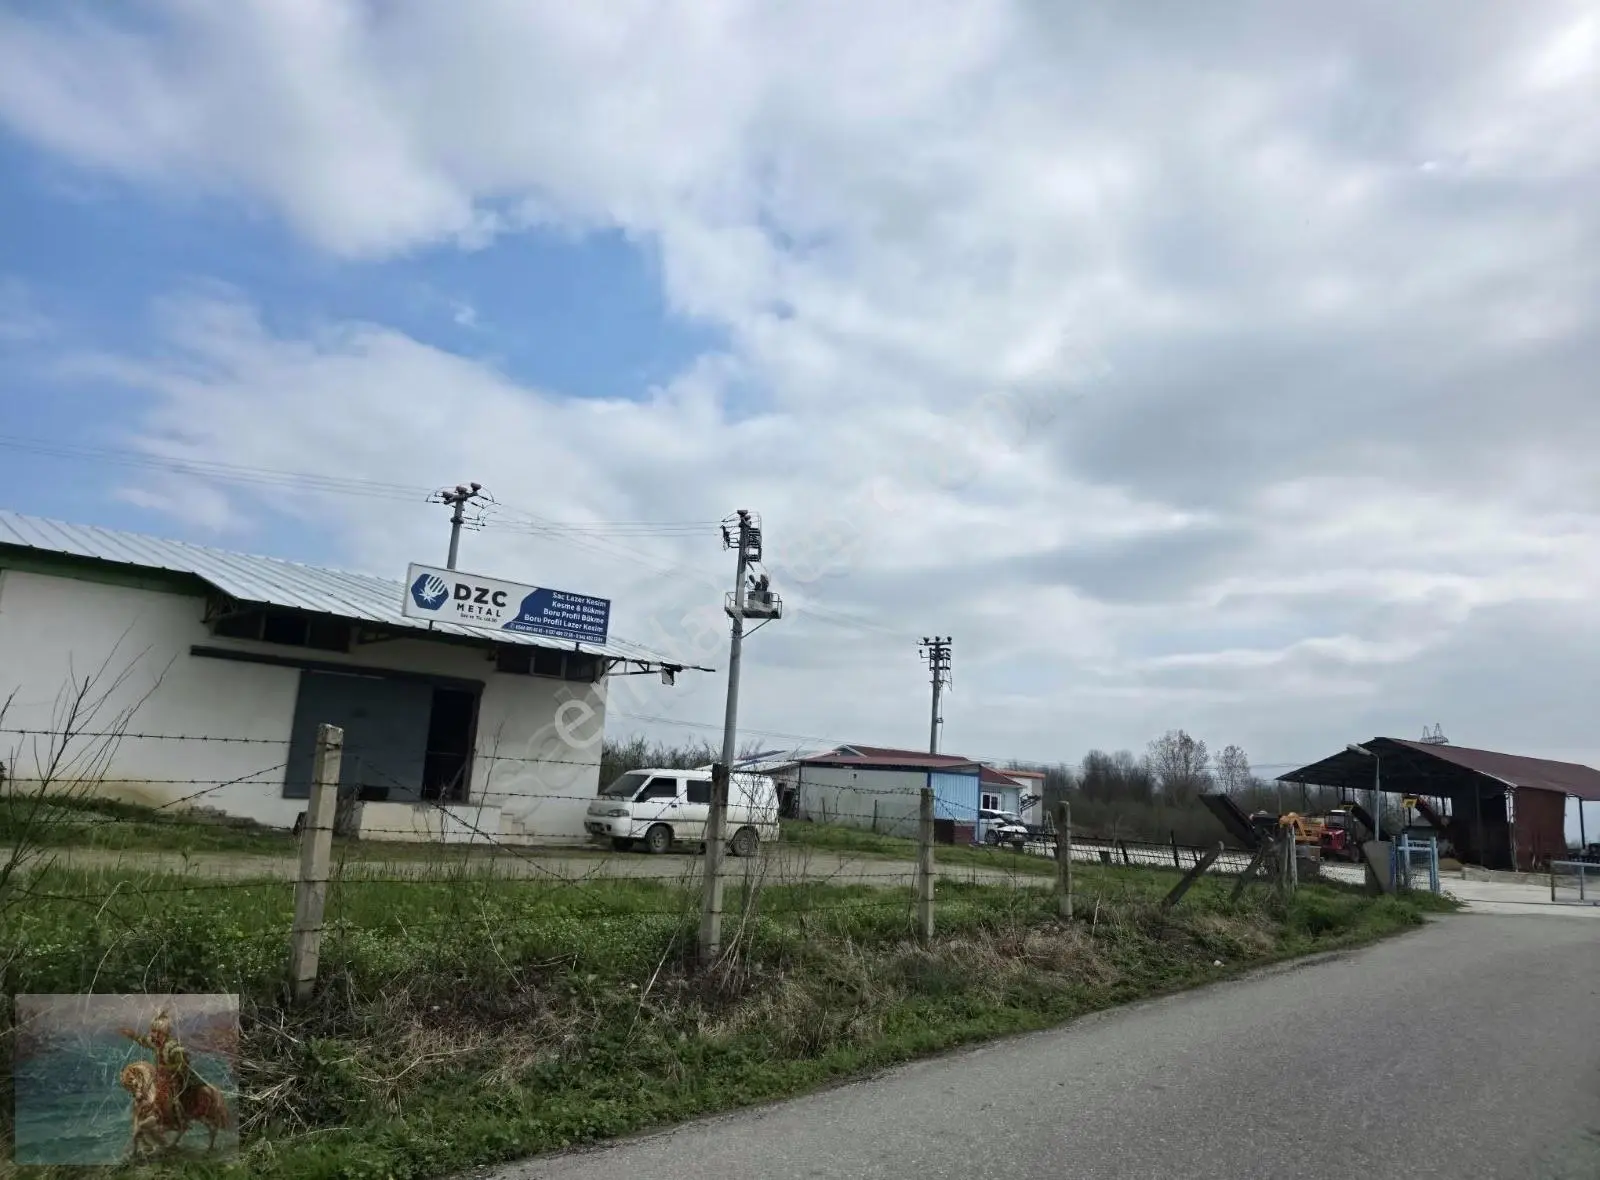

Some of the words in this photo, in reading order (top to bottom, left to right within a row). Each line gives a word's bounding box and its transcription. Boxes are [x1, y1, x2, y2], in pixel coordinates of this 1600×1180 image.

[454, 583, 507, 607] DZC
[566, 594, 585, 603] Lazer
[586, 598, 606, 607] Kesim
[456, 603, 501, 618] METAL
[543, 608, 561, 617] Boru
[561, 610, 580, 620] Profil
[581, 614, 604, 624] Bükme
[552, 601, 575, 611] Kesme
[582, 605, 606, 616] Bükme
[524, 614, 542, 623] Boru
[543, 617, 562, 626] Profil
[563, 620, 582, 629] Lazer
[583, 623, 603, 633] Kesim
